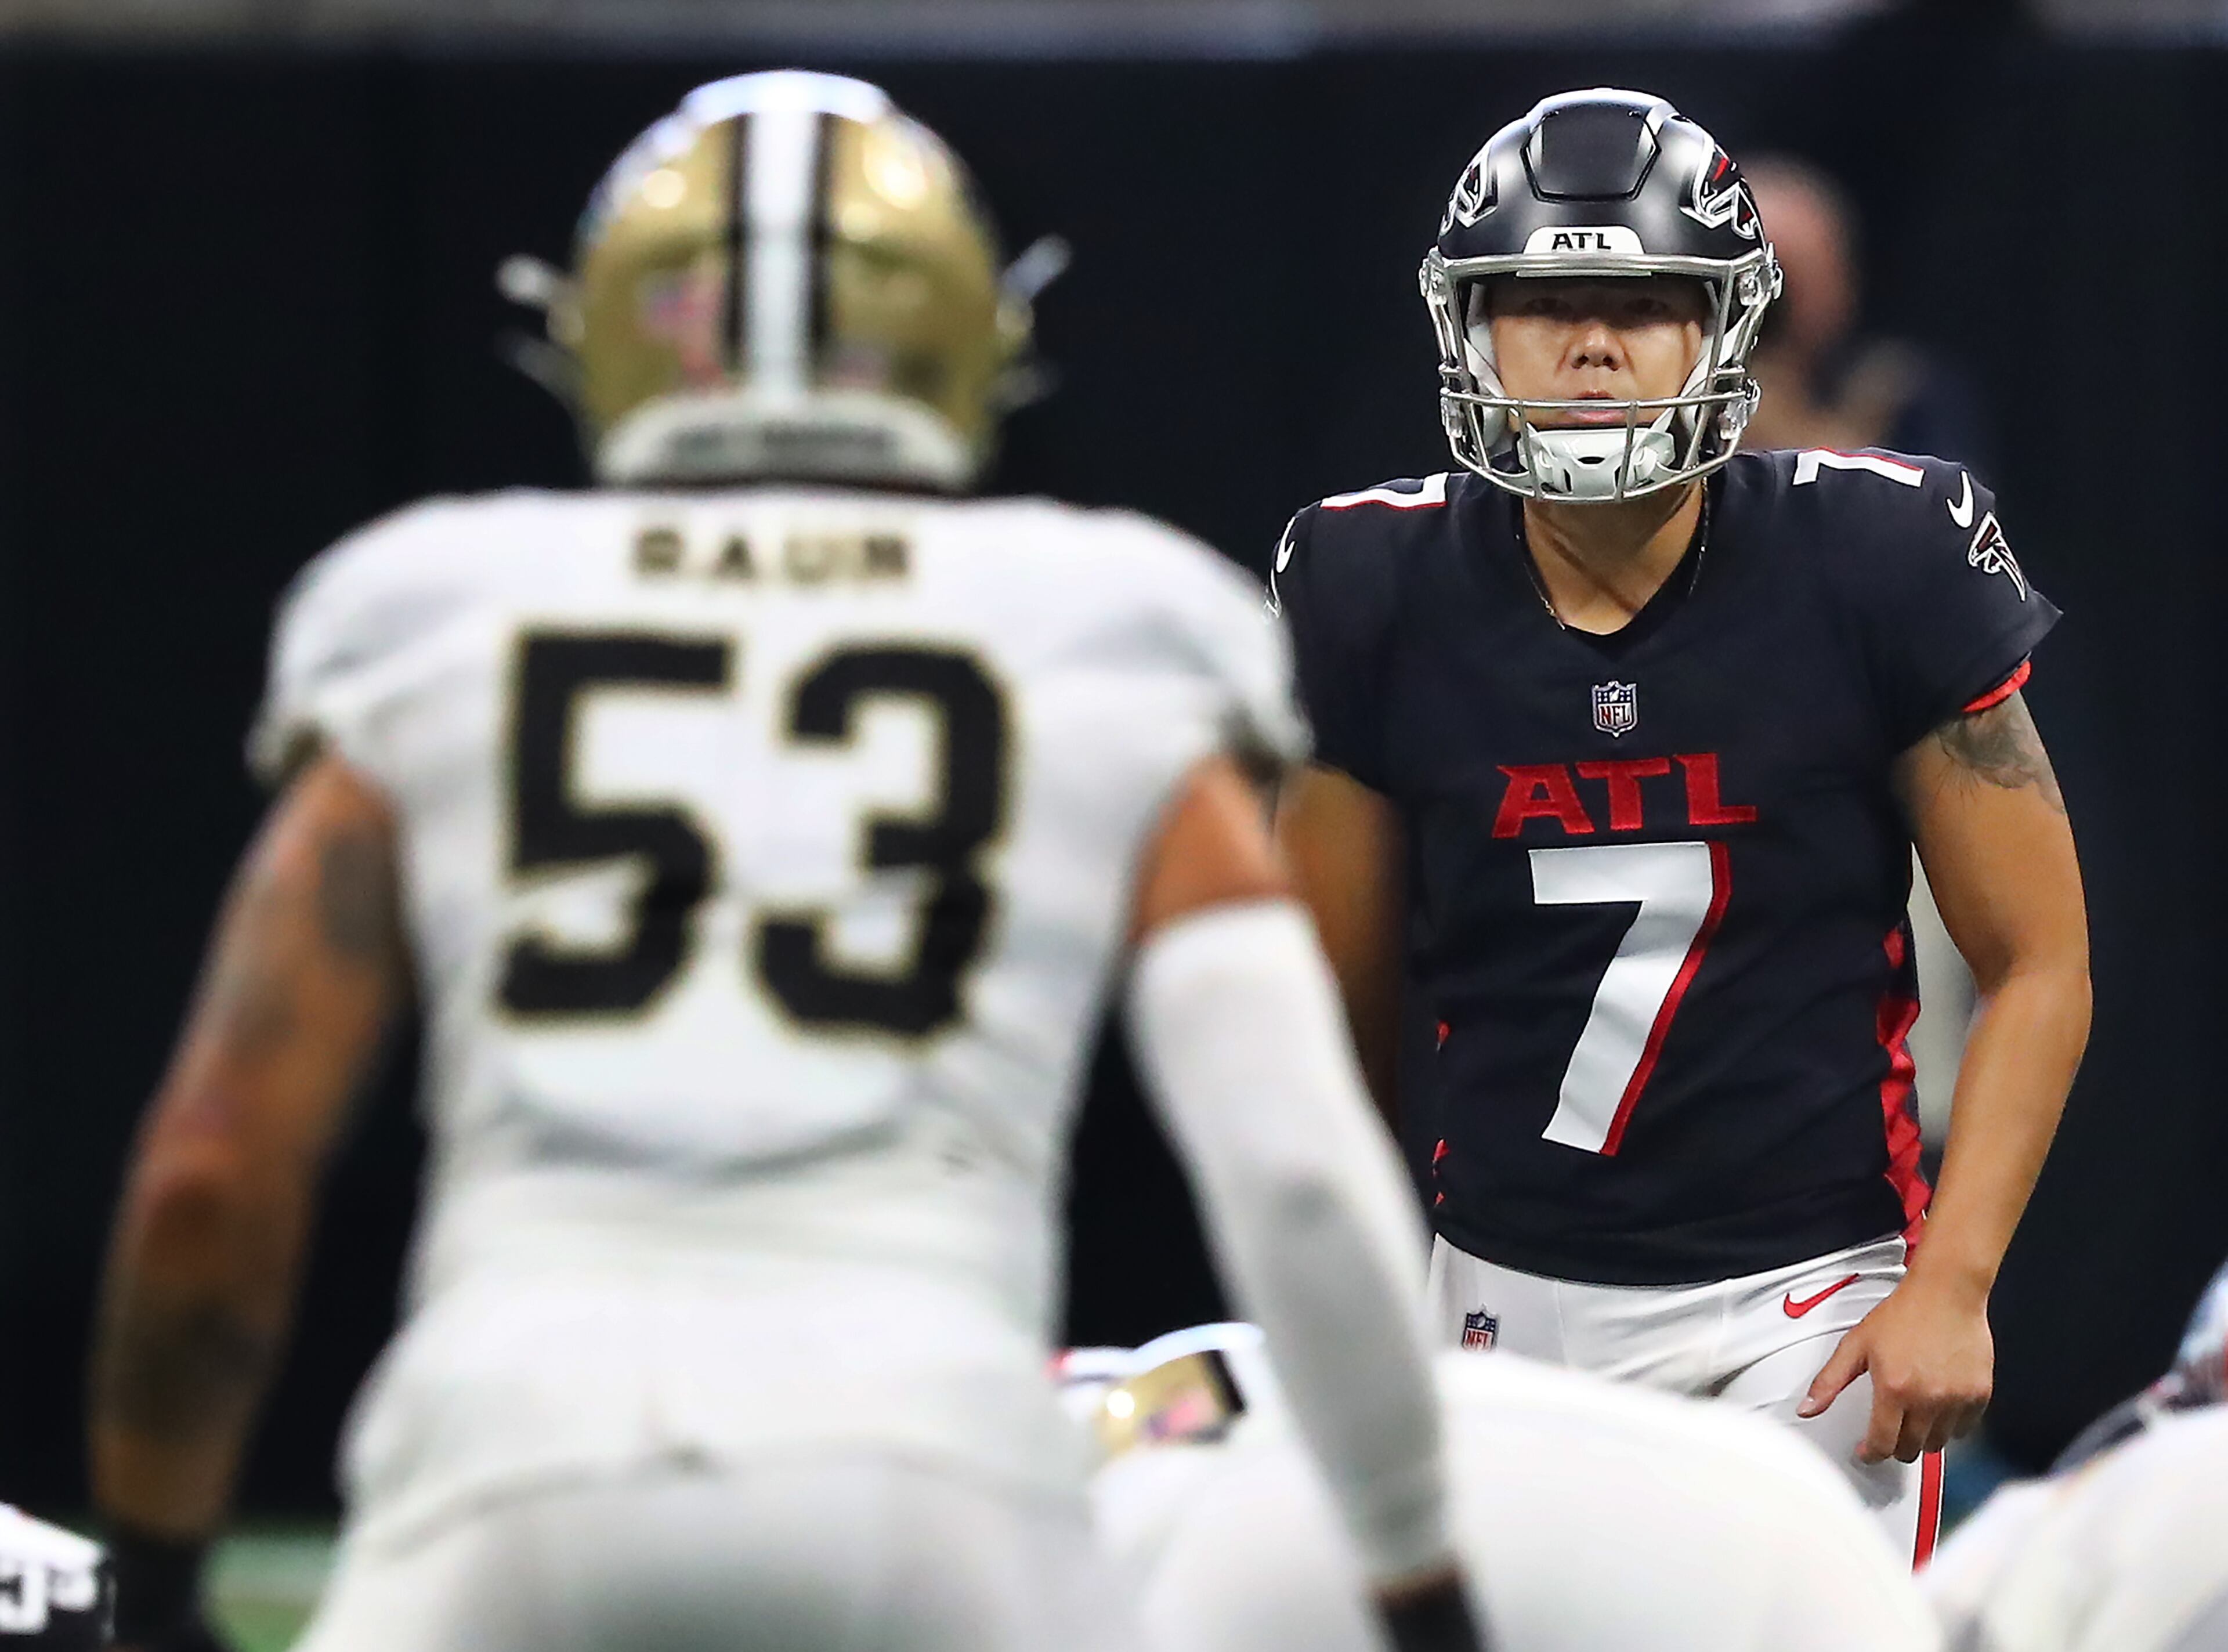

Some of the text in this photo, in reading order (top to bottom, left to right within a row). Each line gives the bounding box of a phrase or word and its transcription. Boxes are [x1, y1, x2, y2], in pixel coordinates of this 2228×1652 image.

[1551, 232, 1612, 250] ATL
[1599, 704, 1632, 726] NFL
[494, 628, 1014, 1044] 53
[1491, 751, 1757, 838] ATL
[1528, 840, 1732, 1156] 7
